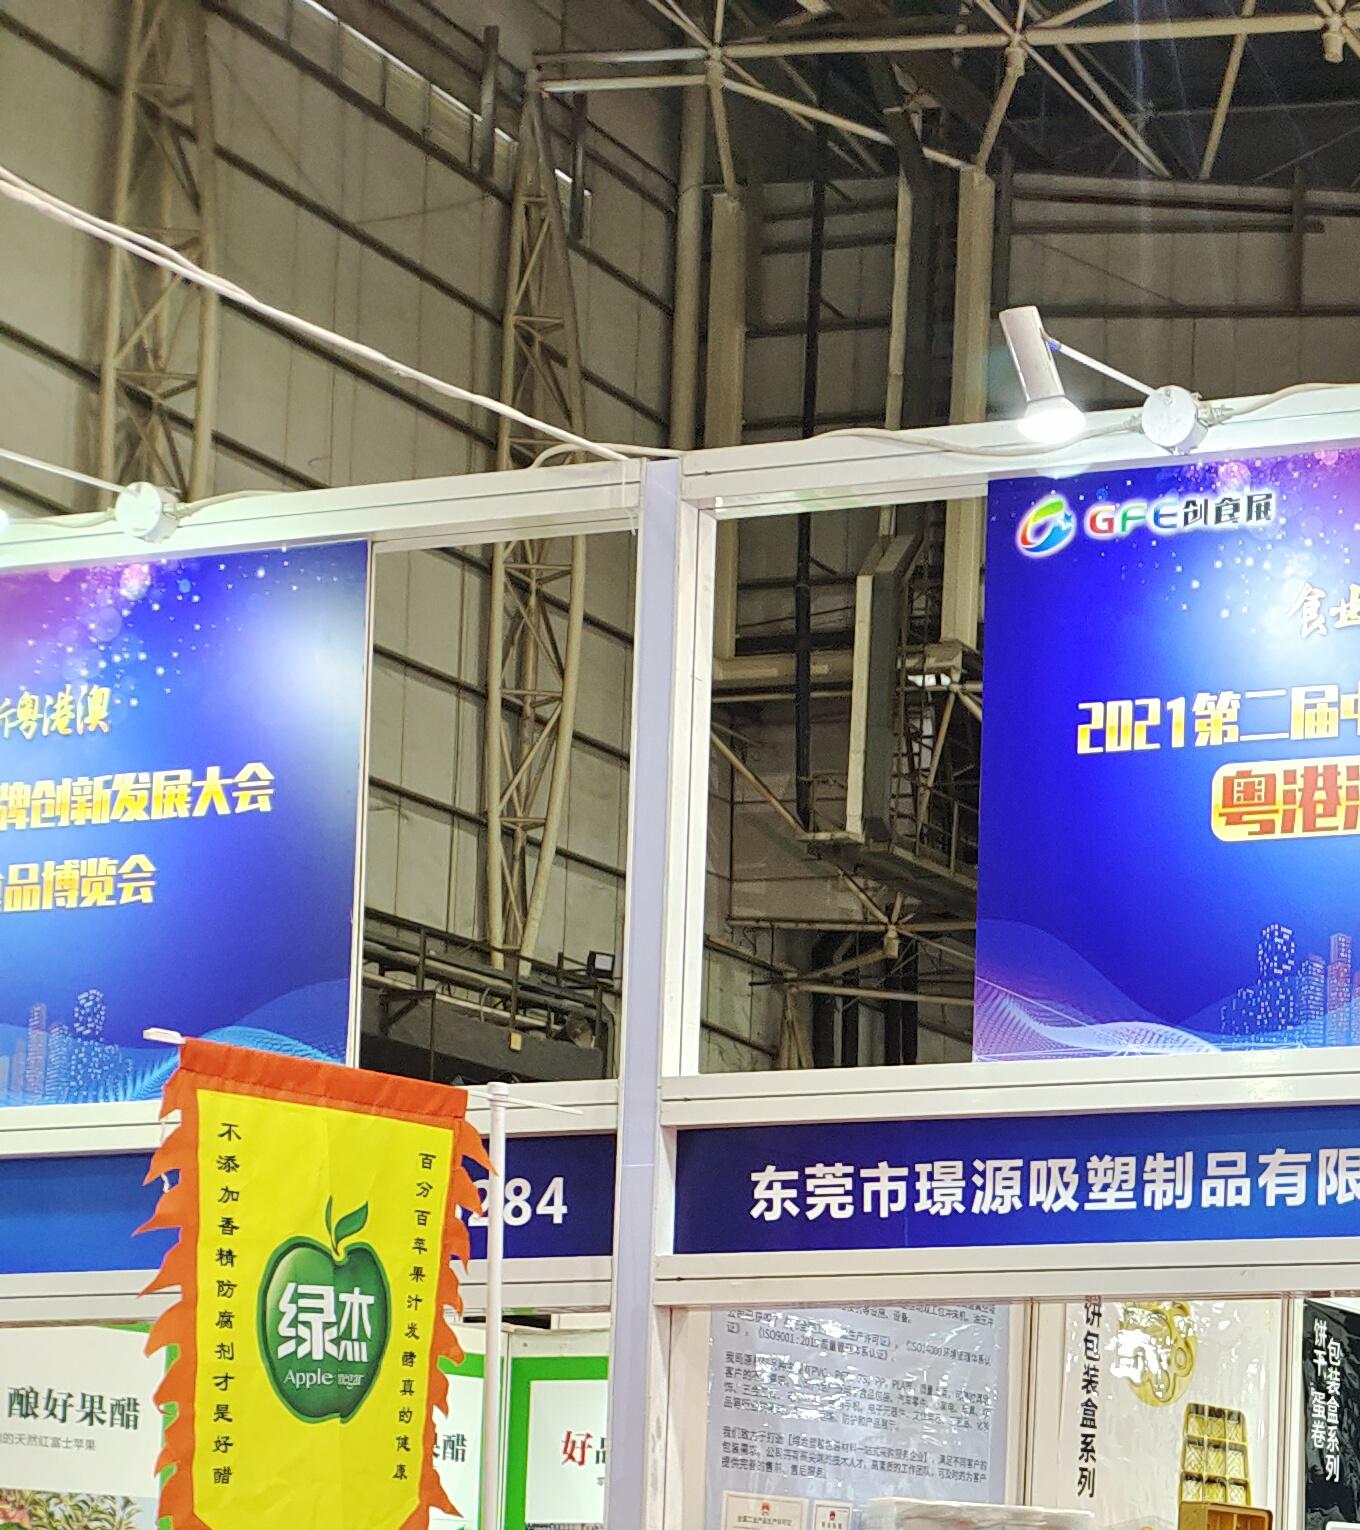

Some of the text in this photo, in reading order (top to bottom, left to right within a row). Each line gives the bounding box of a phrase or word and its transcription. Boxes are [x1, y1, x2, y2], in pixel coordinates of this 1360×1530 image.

[0, 853, 156, 913] 品博览会
[456, 1176, 568, 1226] 284
[212, 1122, 242, 1485] 不添加香精防腐剂才是好醋
[277, 1282, 375, 1362] 绿杰
[392, 1152, 436, 1480] 百分百苹果汁发酵真的健康
[7, 1386, 140, 1430] 酿好果醋
[283, 1367, 334, 1389] Apple
[1325, 1337, 1341, 1482] 包装盒系列
